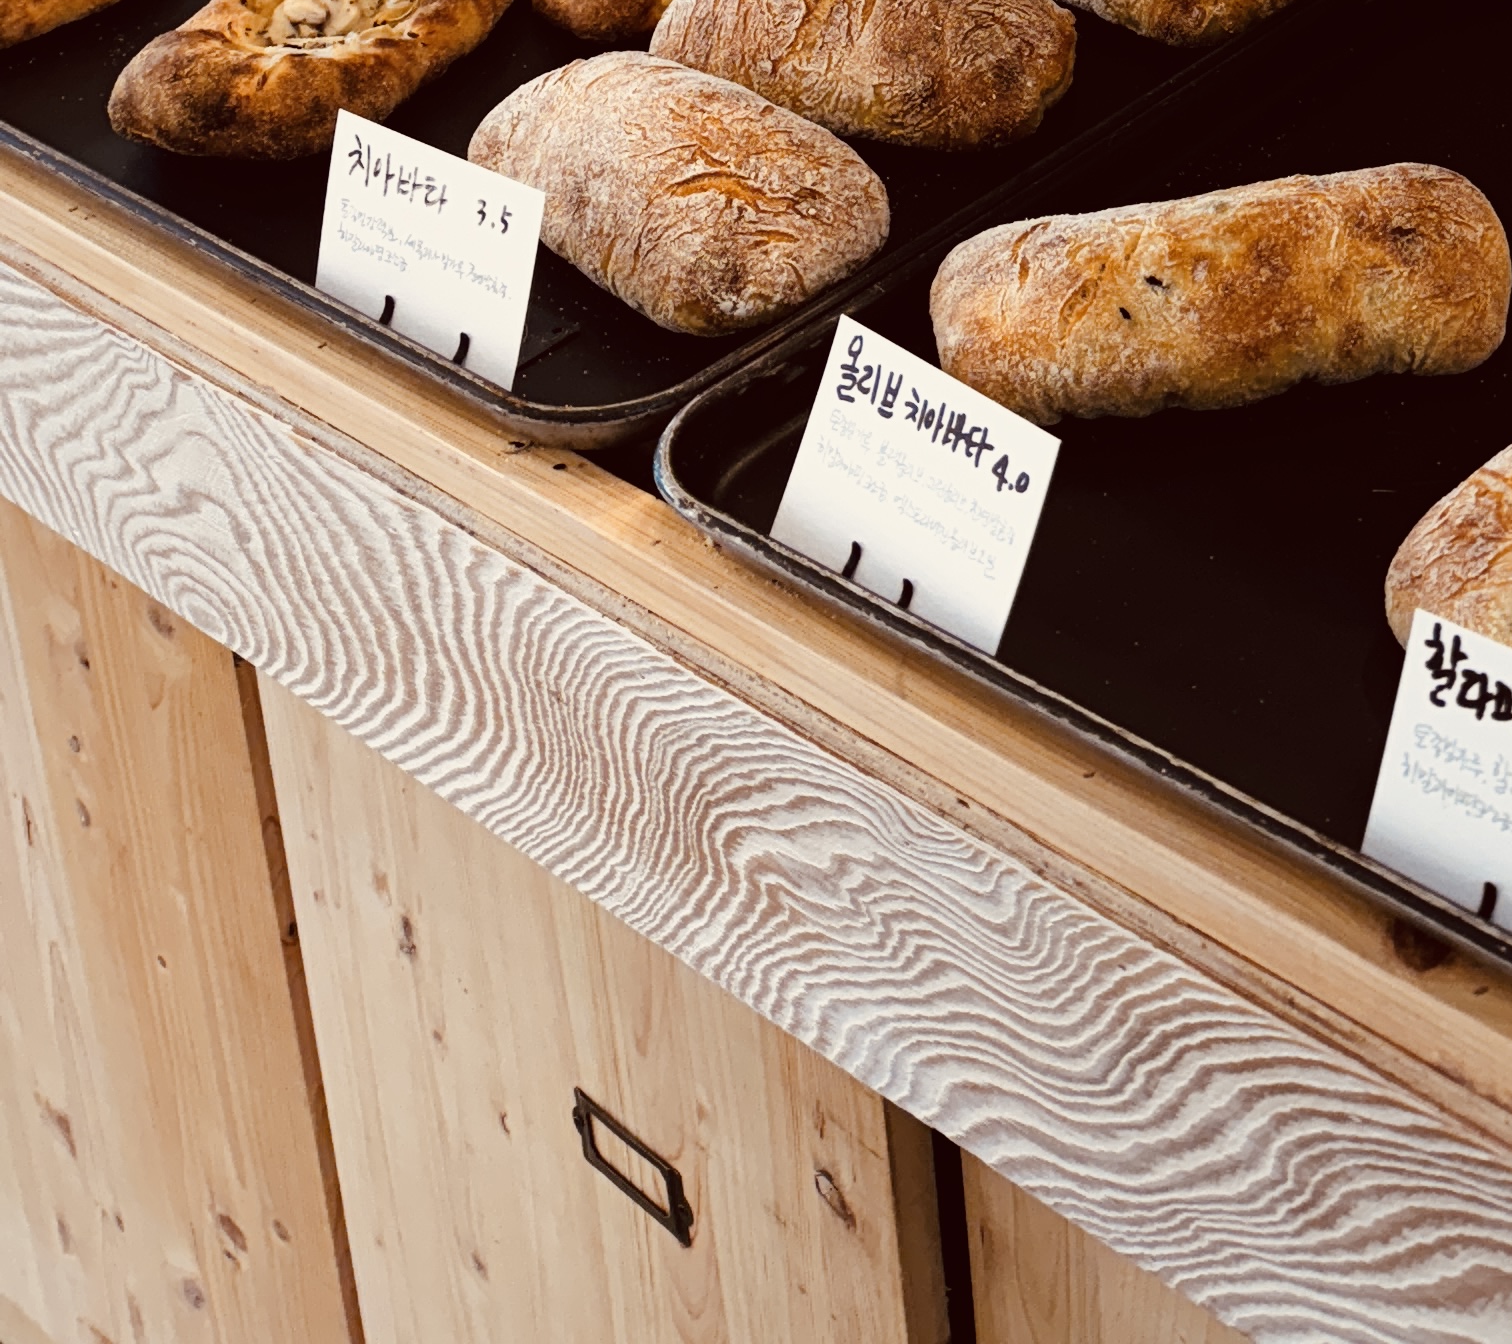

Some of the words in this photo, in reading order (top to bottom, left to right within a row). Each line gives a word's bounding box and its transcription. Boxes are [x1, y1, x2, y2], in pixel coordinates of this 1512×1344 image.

[347, 133, 449, 214] 치아바타
[476, 198, 513, 235] 3.5
[835, 334, 904, 420] 올리브
[903, 386, 996, 468] 치아바타
[991, 453, 1031, 494] 4.0
